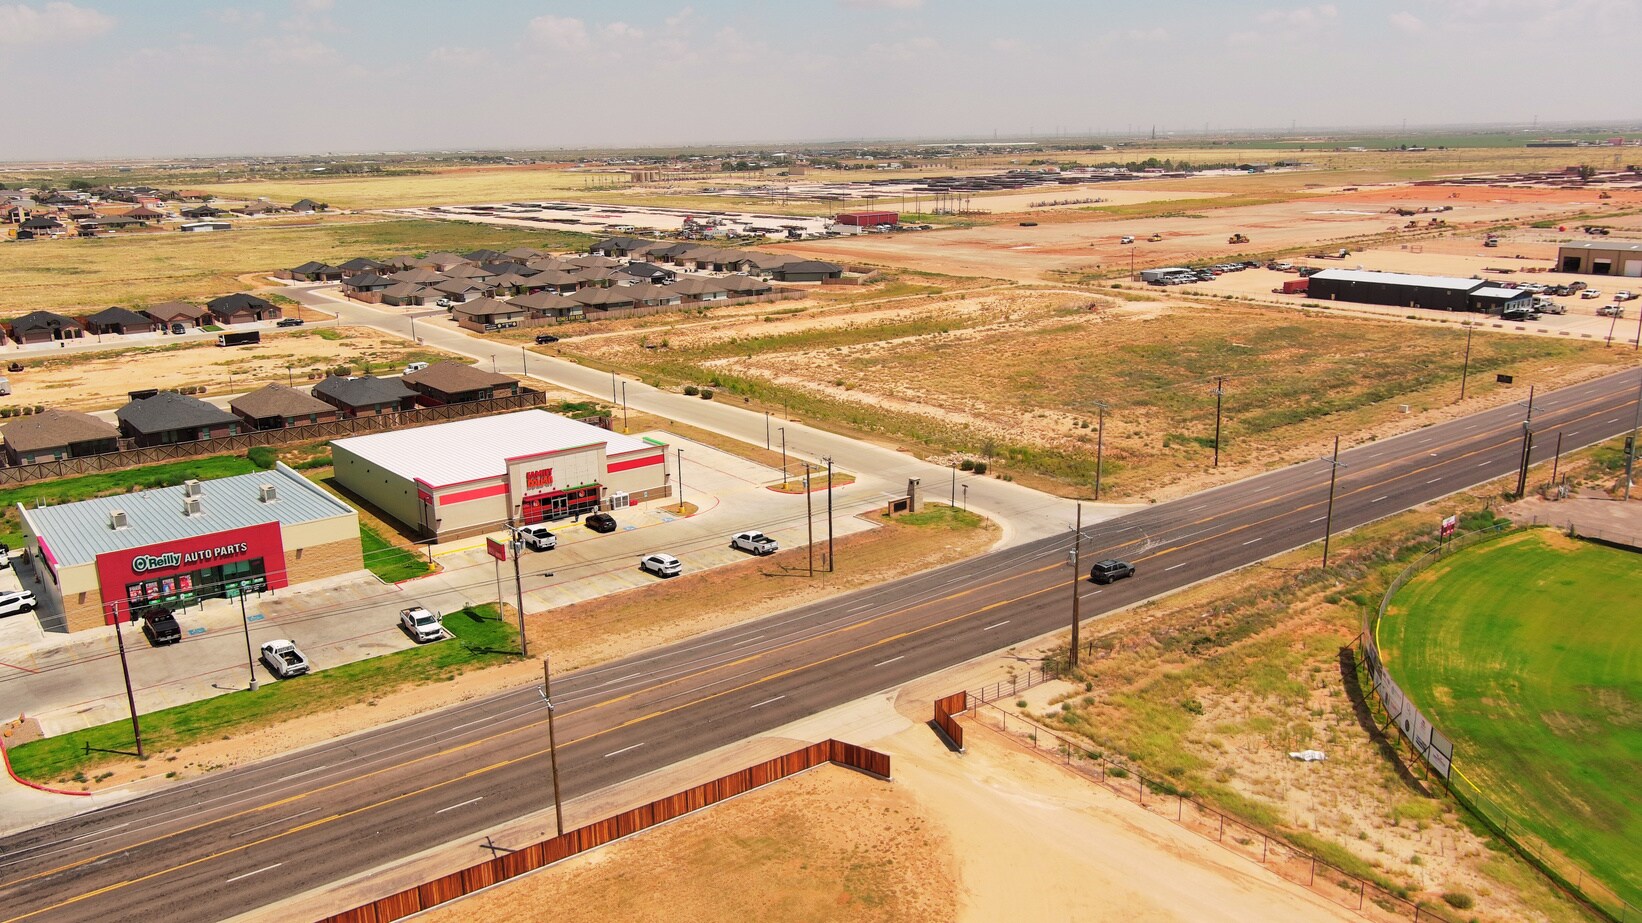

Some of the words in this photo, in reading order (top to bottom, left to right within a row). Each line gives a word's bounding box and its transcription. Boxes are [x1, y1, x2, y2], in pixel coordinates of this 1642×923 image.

[526, 468, 552, 479] FAMILY
[527, 475, 553, 489] DOLLAR
[133, 552, 181, 571] O'Reilly
[185, 549, 212, 562] AUTO
[214, 542, 247, 556] PARTS
